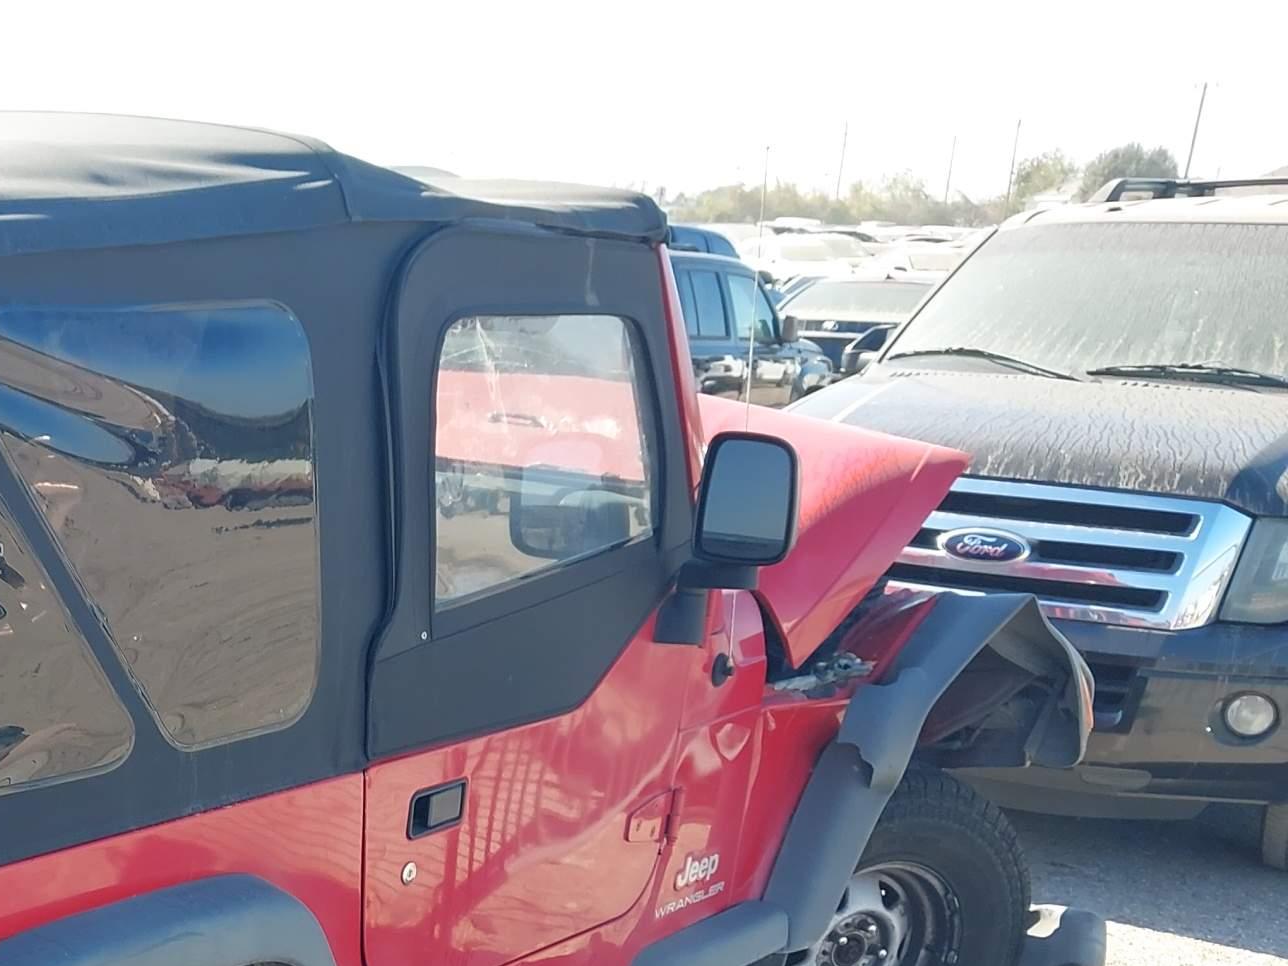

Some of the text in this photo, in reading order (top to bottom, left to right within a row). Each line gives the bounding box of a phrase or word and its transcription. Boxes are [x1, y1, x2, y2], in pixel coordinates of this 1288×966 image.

[955, 534, 1008, 557] Ford
[675, 853, 720, 889] Jeep
[654, 881, 725, 919] WRANGLER
